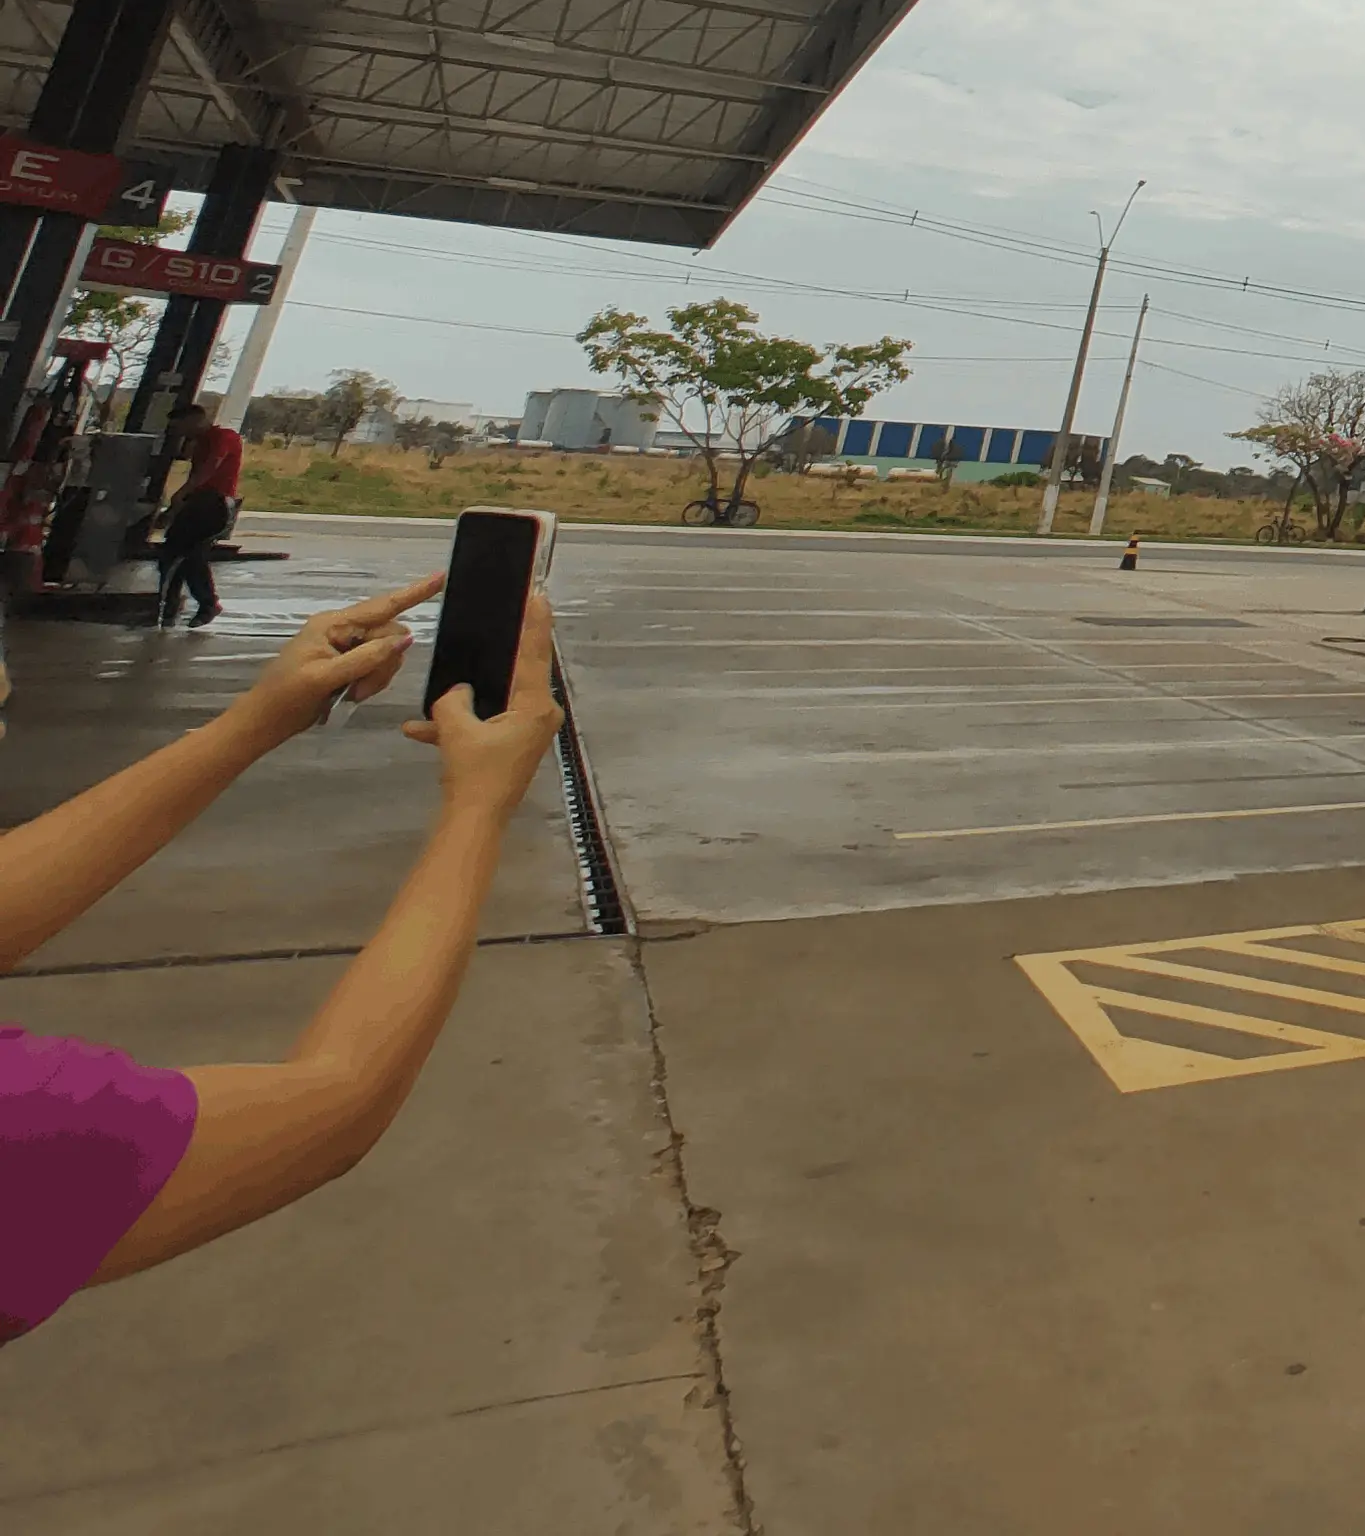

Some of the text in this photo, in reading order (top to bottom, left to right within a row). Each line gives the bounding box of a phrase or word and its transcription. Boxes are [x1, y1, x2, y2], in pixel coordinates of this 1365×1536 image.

[10, 150, 60, 183] E
[121, 179, 157, 210] 4
[250, 273, 274, 295] 2
